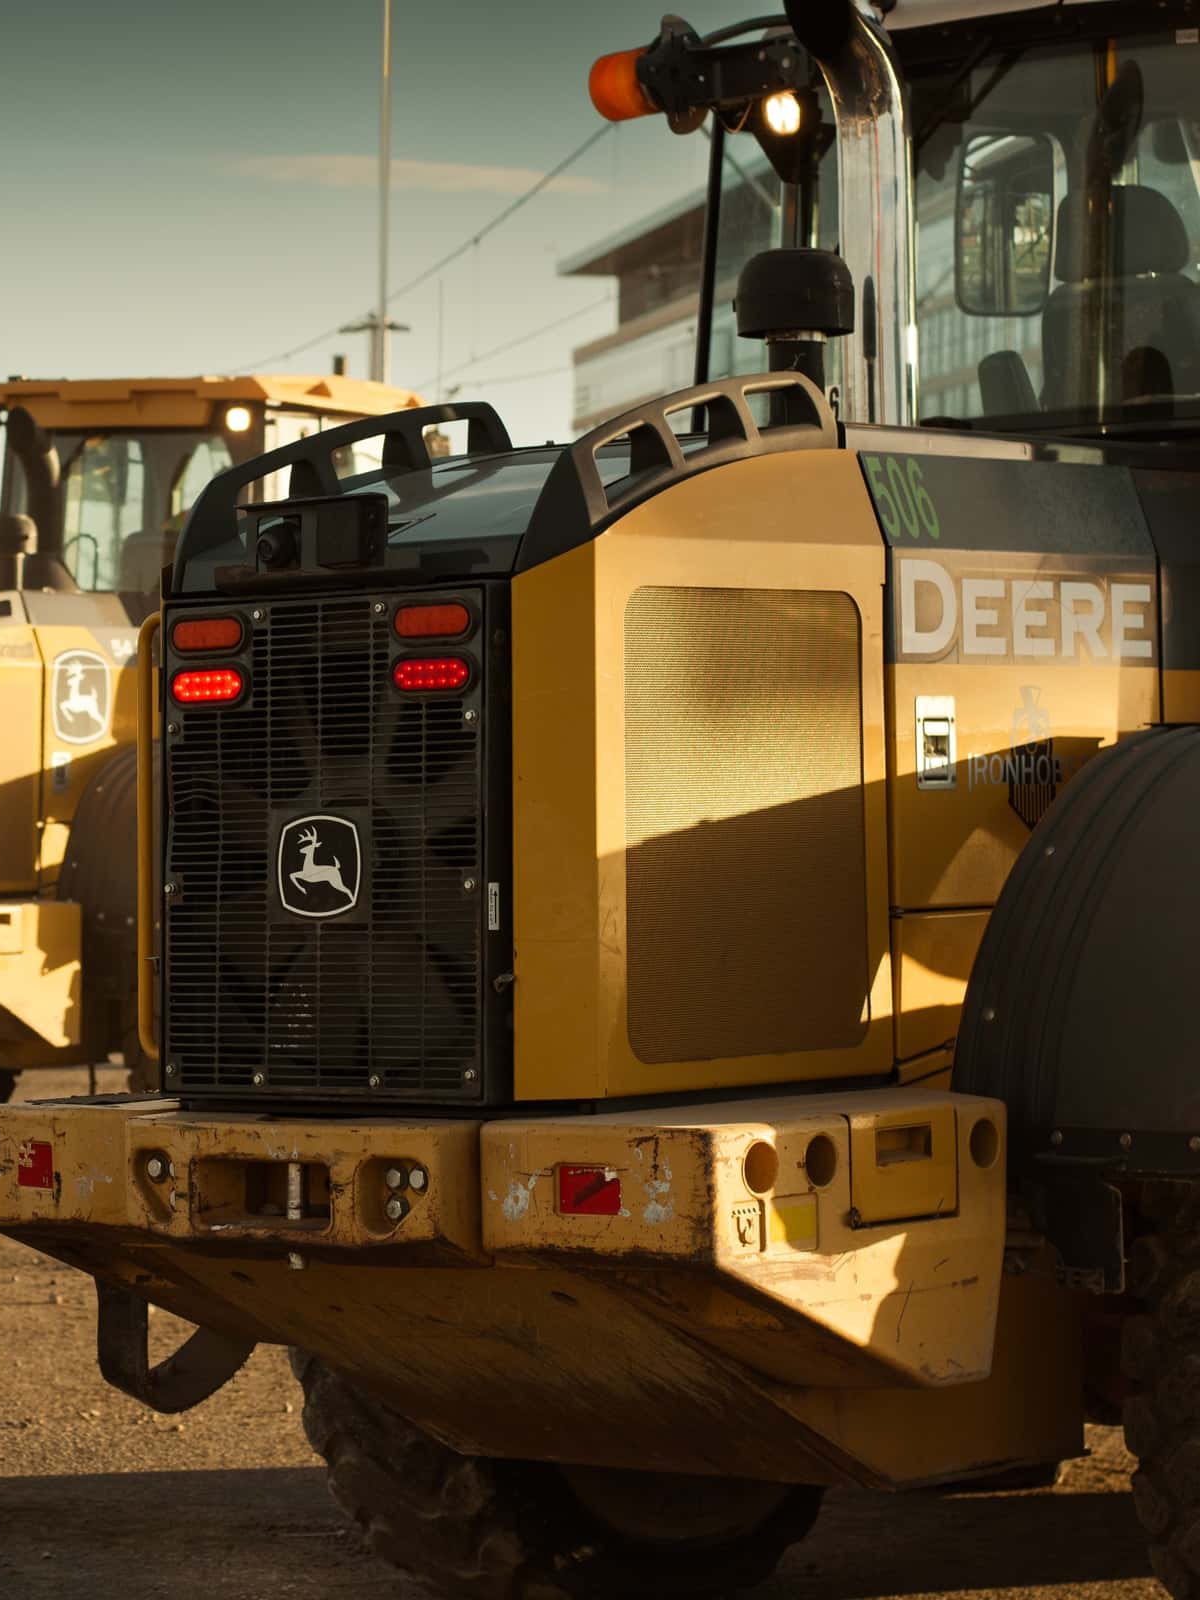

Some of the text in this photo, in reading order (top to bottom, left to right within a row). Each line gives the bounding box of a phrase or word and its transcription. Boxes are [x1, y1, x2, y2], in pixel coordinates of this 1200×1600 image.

[864, 455, 940, 540] 506
[111, 639, 137, 657] 54
[900, 559, 1153, 658] DEERE
